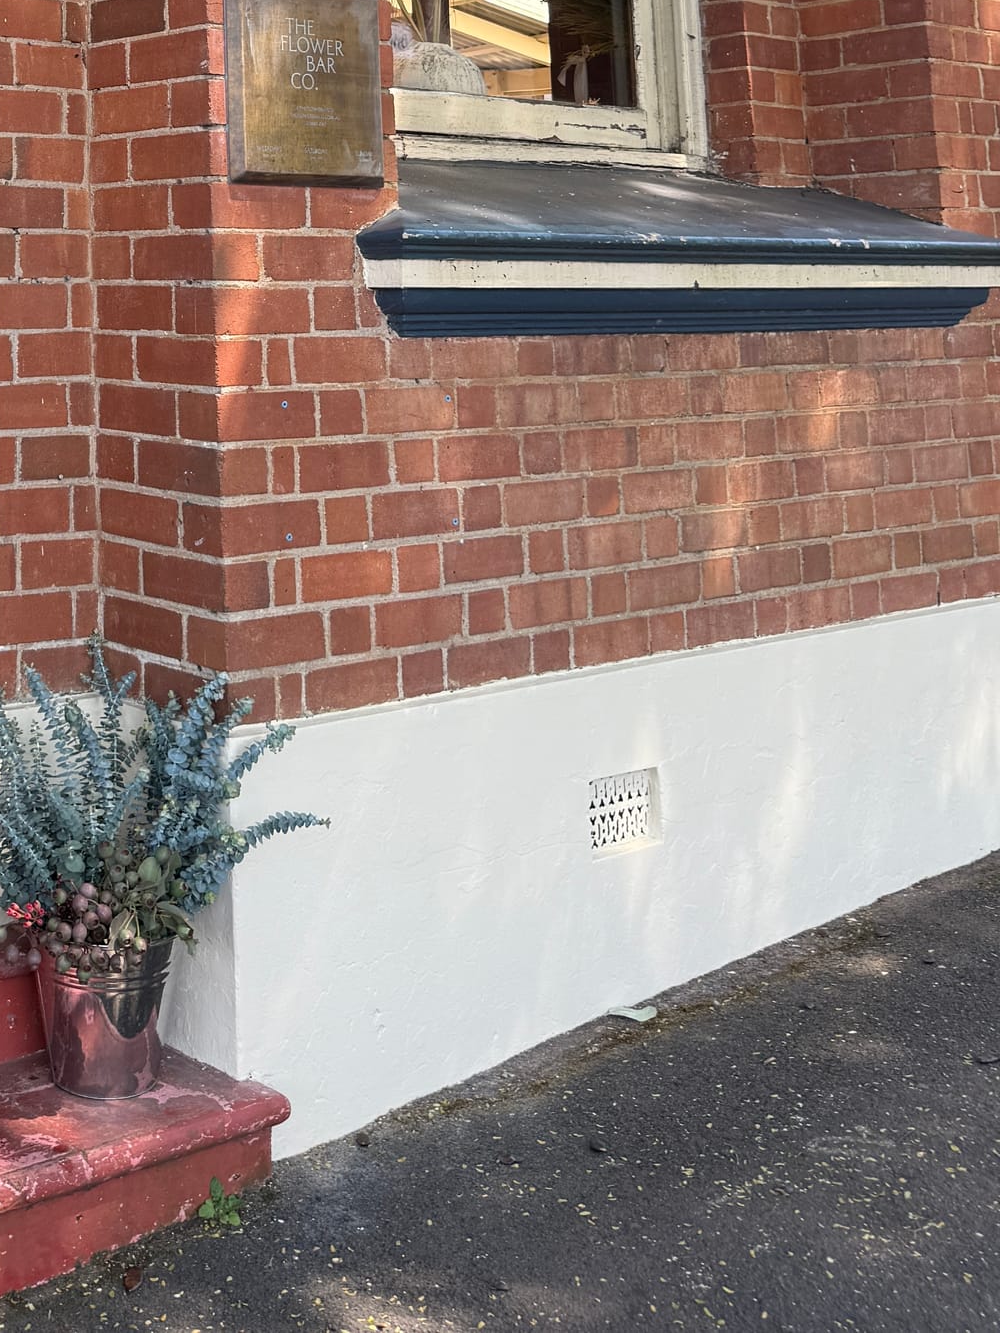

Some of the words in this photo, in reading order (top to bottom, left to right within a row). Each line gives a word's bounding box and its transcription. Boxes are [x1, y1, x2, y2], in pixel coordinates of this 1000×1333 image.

[285, 17, 315, 36] THE
[280, 34, 344, 57] FLOWER
[306, 55, 336, 74] BAR
[290, 72, 319, 91] CO.
